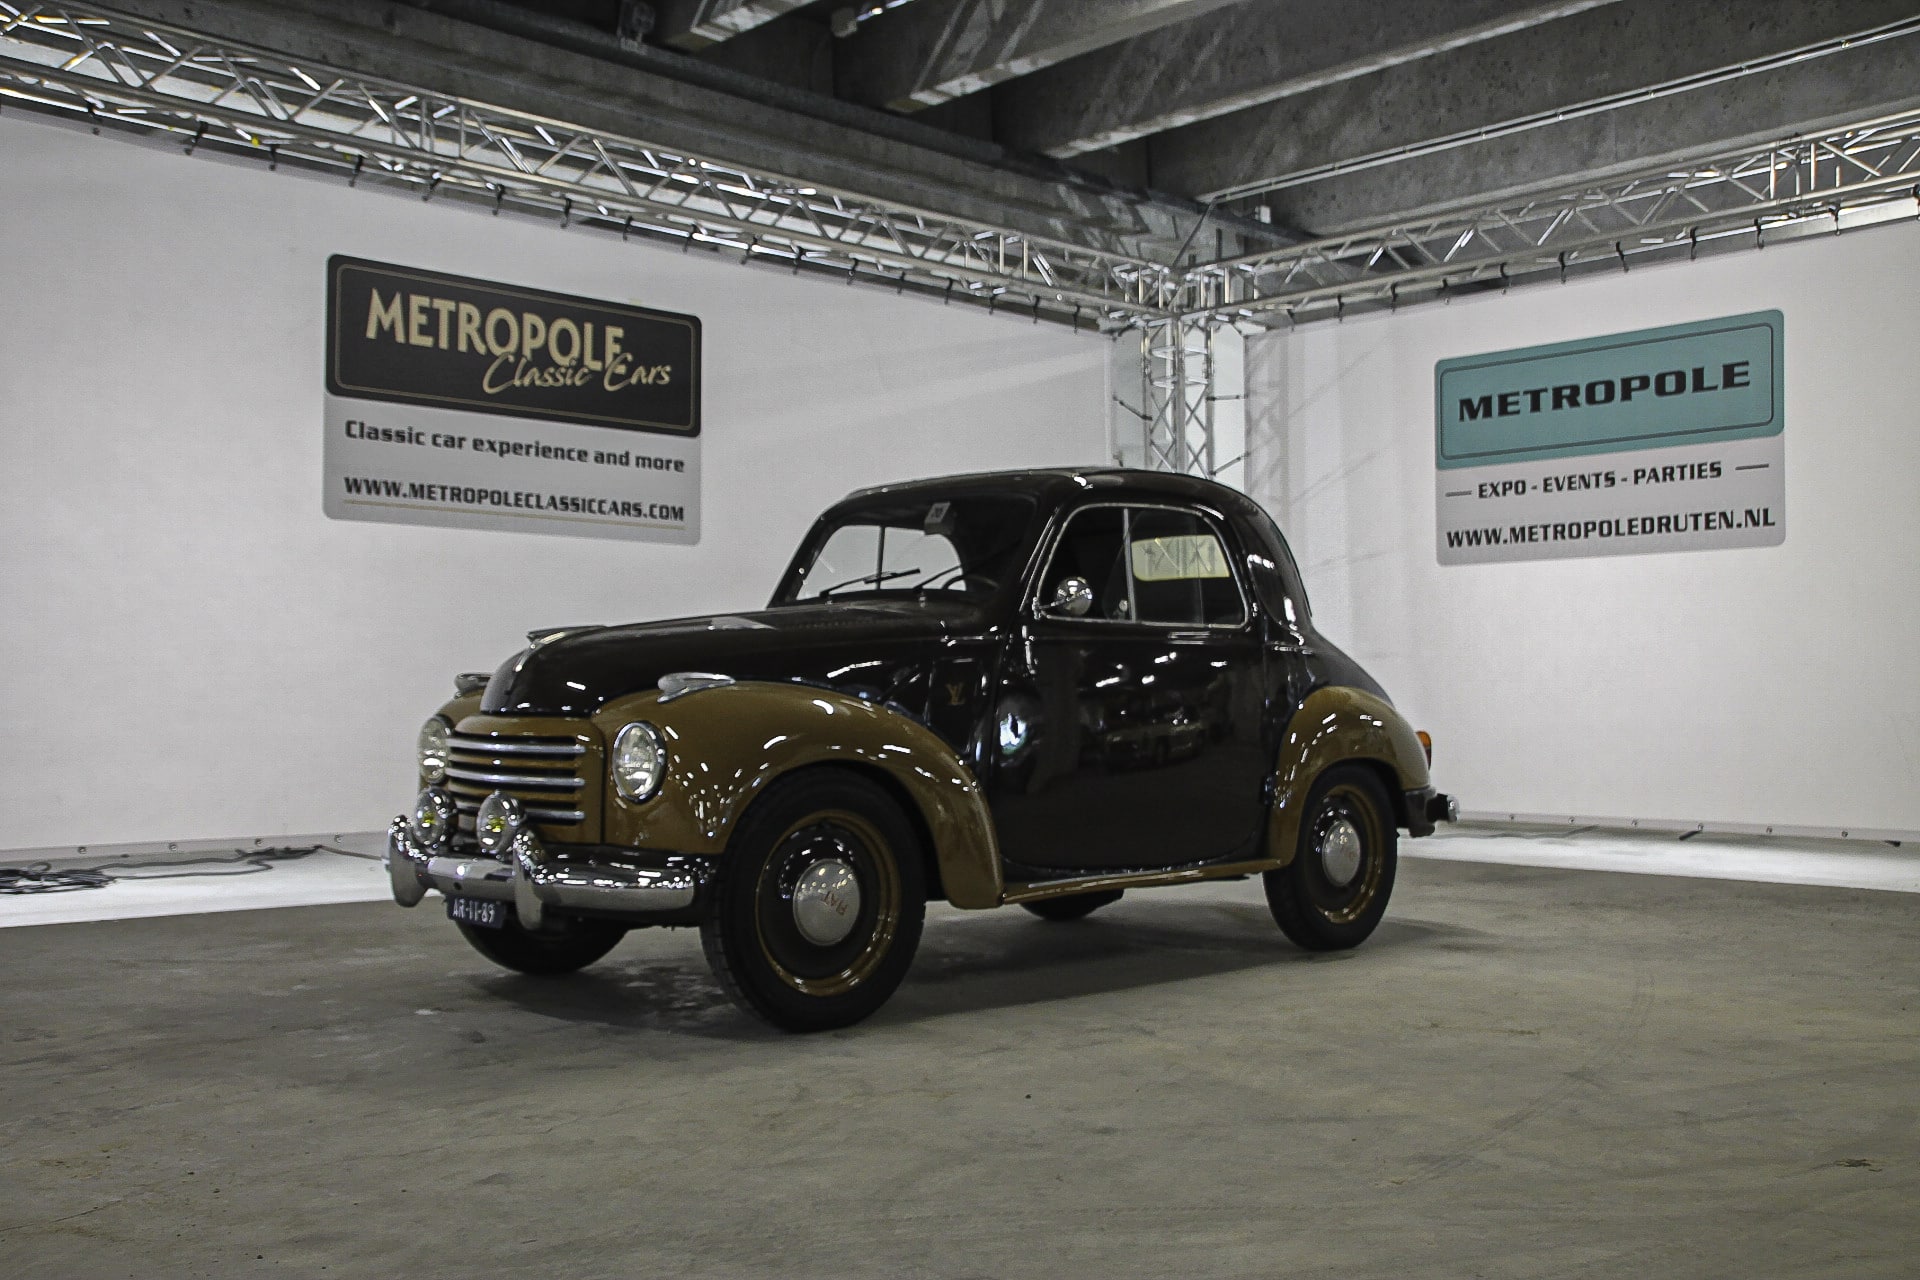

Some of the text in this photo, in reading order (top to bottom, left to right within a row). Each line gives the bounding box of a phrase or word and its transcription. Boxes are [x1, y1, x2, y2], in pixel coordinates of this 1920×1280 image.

[366, 287, 626, 375] METROPOLE
[482, 350, 672, 394] Classic Cars
[1458, 361, 1751, 422] METROPOLE
[345, 420, 685, 473] Classic car experience and more
[344, 477, 685, 522] WWW.METROPOLECLASSICCARS.COM
[1478, 479, 1526, 499] EXPO
[1542, 470, 1616, 493] EVENTS
[1633, 460, 1722, 485] PARTIES
[1446, 507, 1776, 548] WWW.METROPOLEDRUTEN.NL
